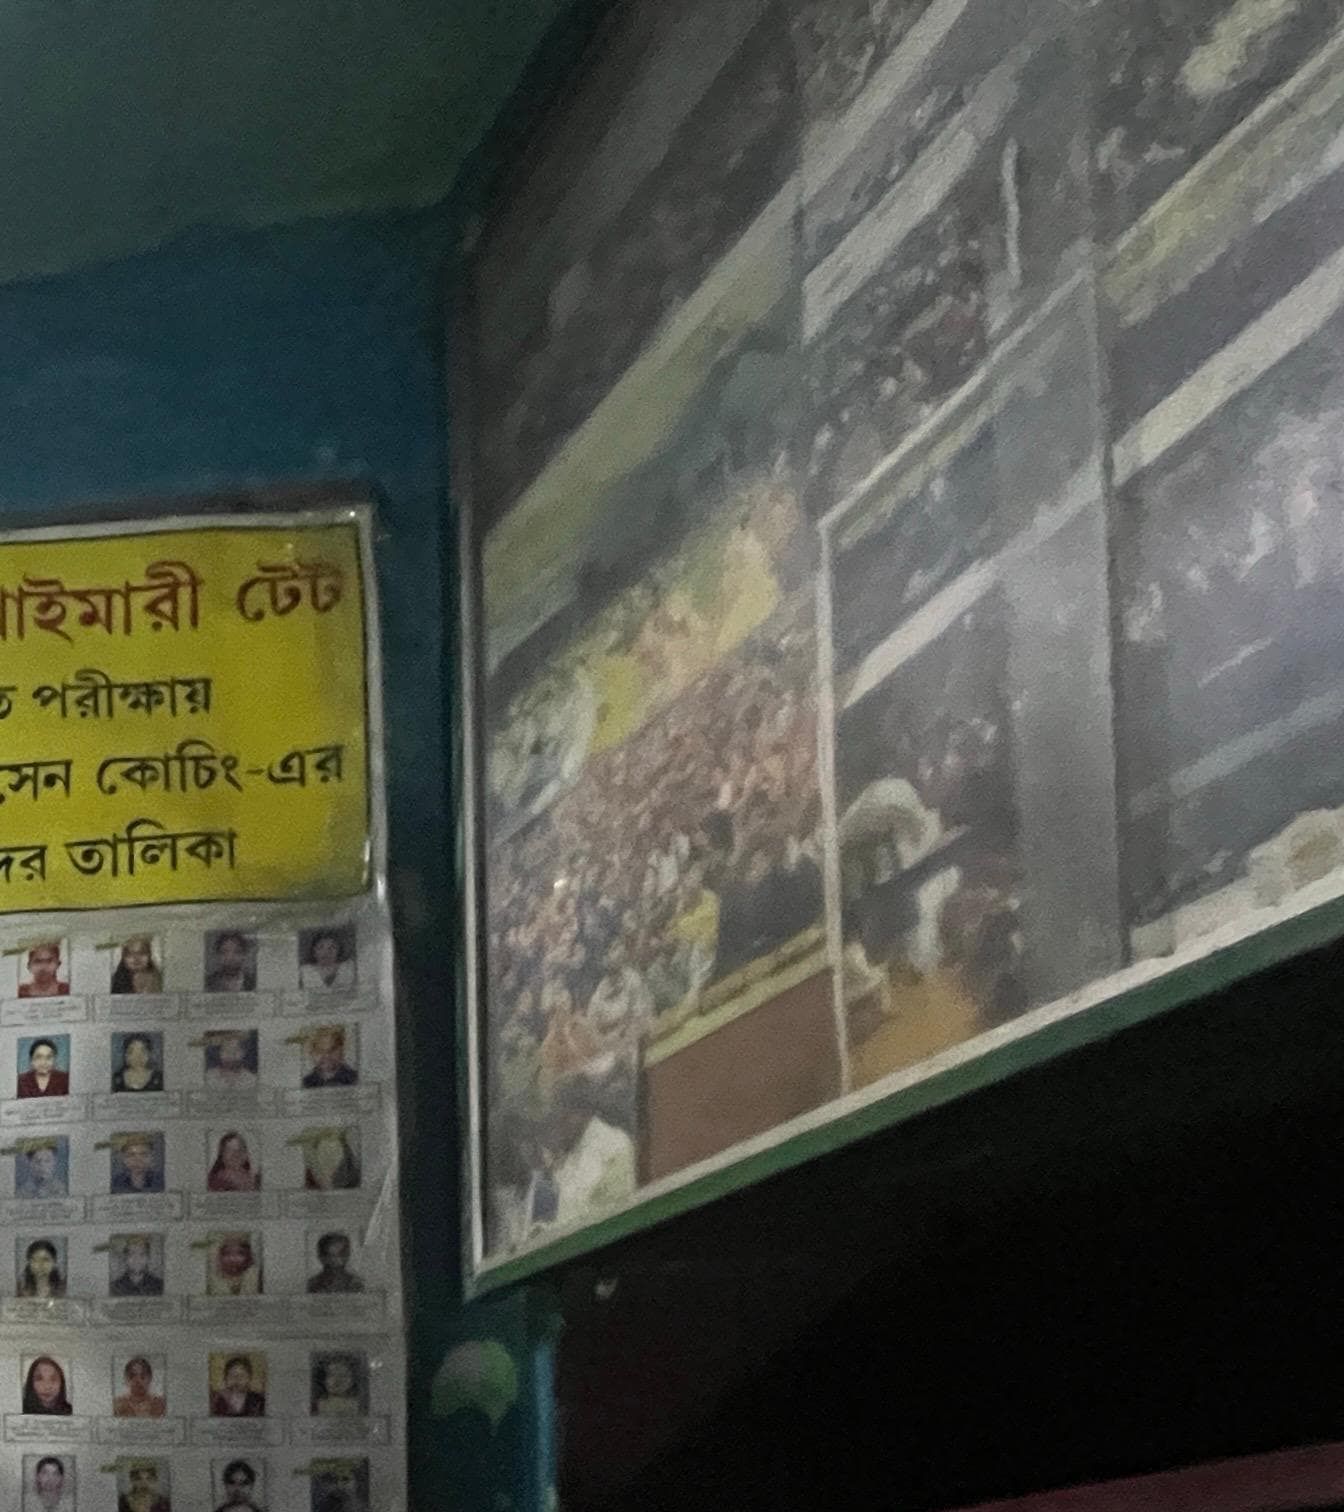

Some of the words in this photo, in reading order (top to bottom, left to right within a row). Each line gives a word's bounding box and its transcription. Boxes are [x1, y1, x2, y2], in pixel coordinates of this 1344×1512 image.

[237, 560, 344, 621] টেট
[32, 667, 212, 719] পরীক্ষায়
[96, 738, 344, 792] কোচিং-এর
[65, 817, 236, 876] তালিকা
